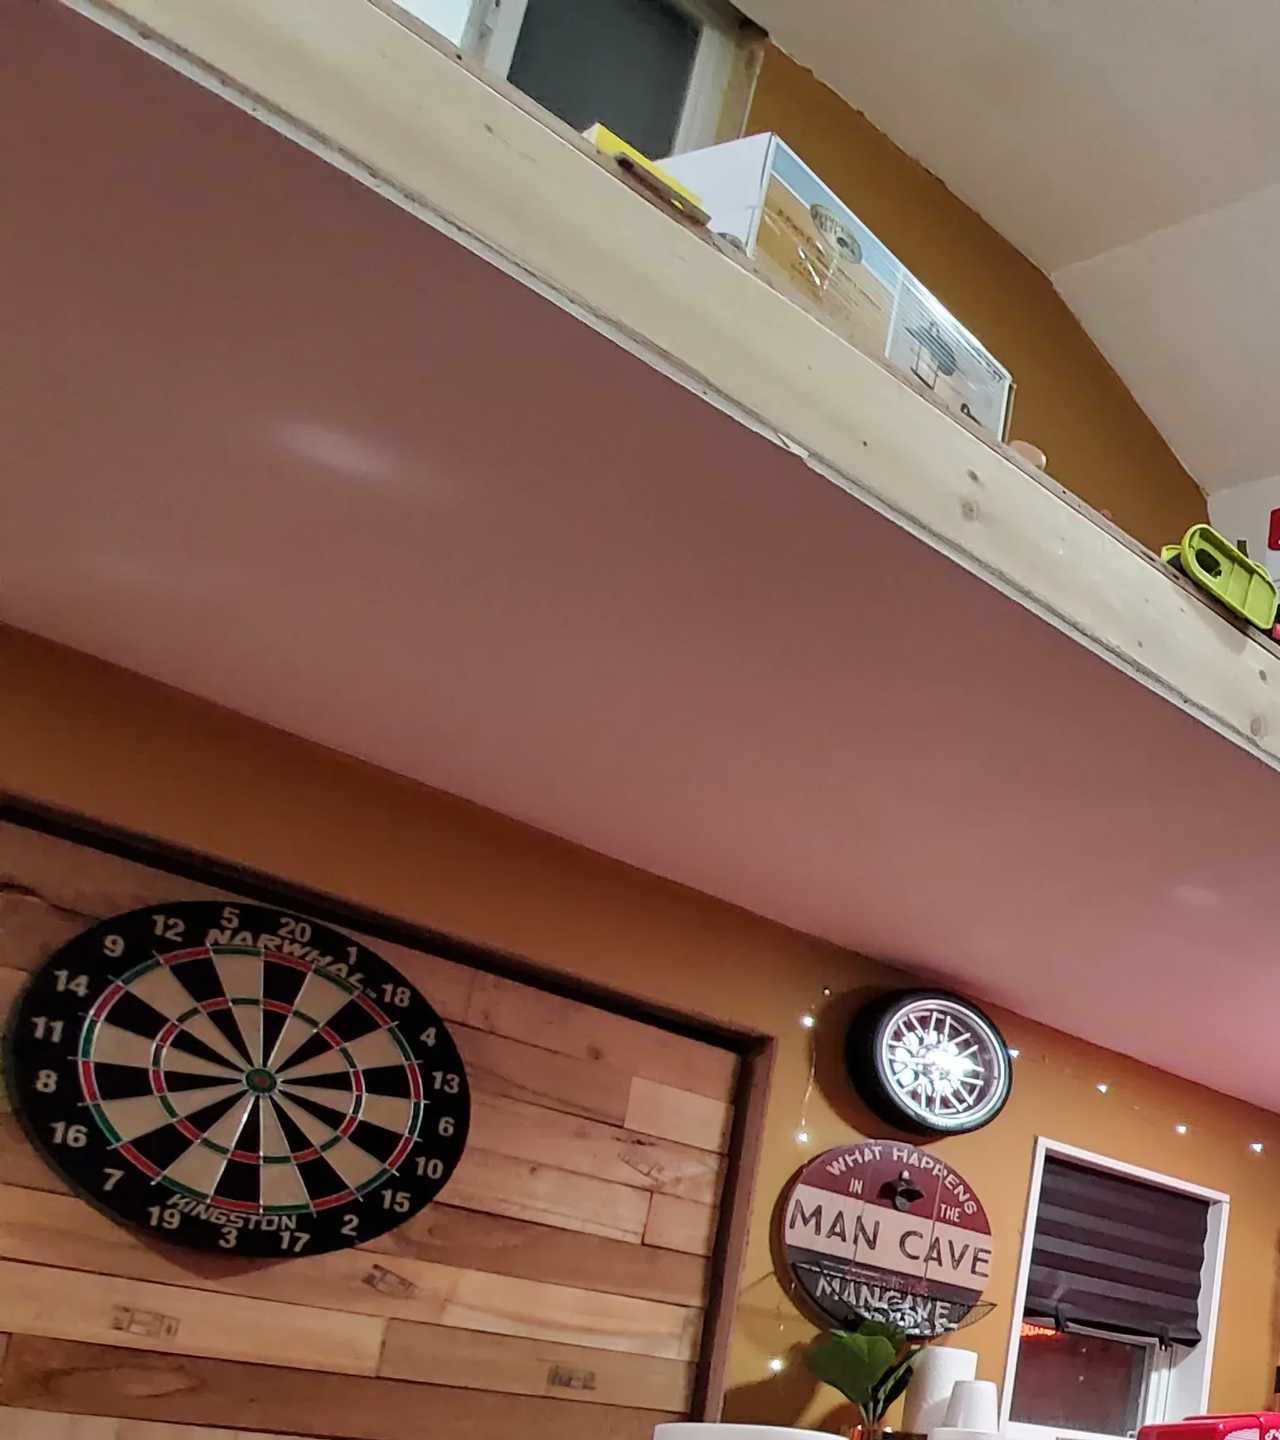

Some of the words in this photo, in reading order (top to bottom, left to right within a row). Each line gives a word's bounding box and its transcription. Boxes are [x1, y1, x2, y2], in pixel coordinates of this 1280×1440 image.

[151, 914, 185, 941] 12
[220, 907, 240, 929] 5
[279, 917, 312, 943] 20
[104, 934, 125, 957] 9
[346, 946, 358, 964] 1
[53, 970, 89, 997] 14
[380, 984, 411, 1008] 18
[31, 1017, 64, 1042] 11
[420, 1027, 436, 1046] 4
[35, 1069, 57, 1093] 8
[431, 1070, 460, 1093] 13
[50, 1121, 88, 1148] 16
[438, 1116, 454, 1136] 6
[415, 1156, 443, 1178] 10
[102, 1168, 125, 1192] 7
[826, 1146, 883, 1177] WHAT
[892, 1147, 978, 1216] HAPPENS
[381, 1189, 410, 1213] 15
[848, 1176, 864, 1195] IN
[939, 1202, 962, 1223] THE
[148, 1206, 181, 1230] 19
[166, 1193, 298, 1232] KINGSTON
[340, 1215, 358, 1236] 2
[218, 1228, 237, 1248] 3
[279, 1232, 311, 1252] 17
[789, 1199, 881, 1251] MAN
[898, 1230, 992, 1279] CAVE
